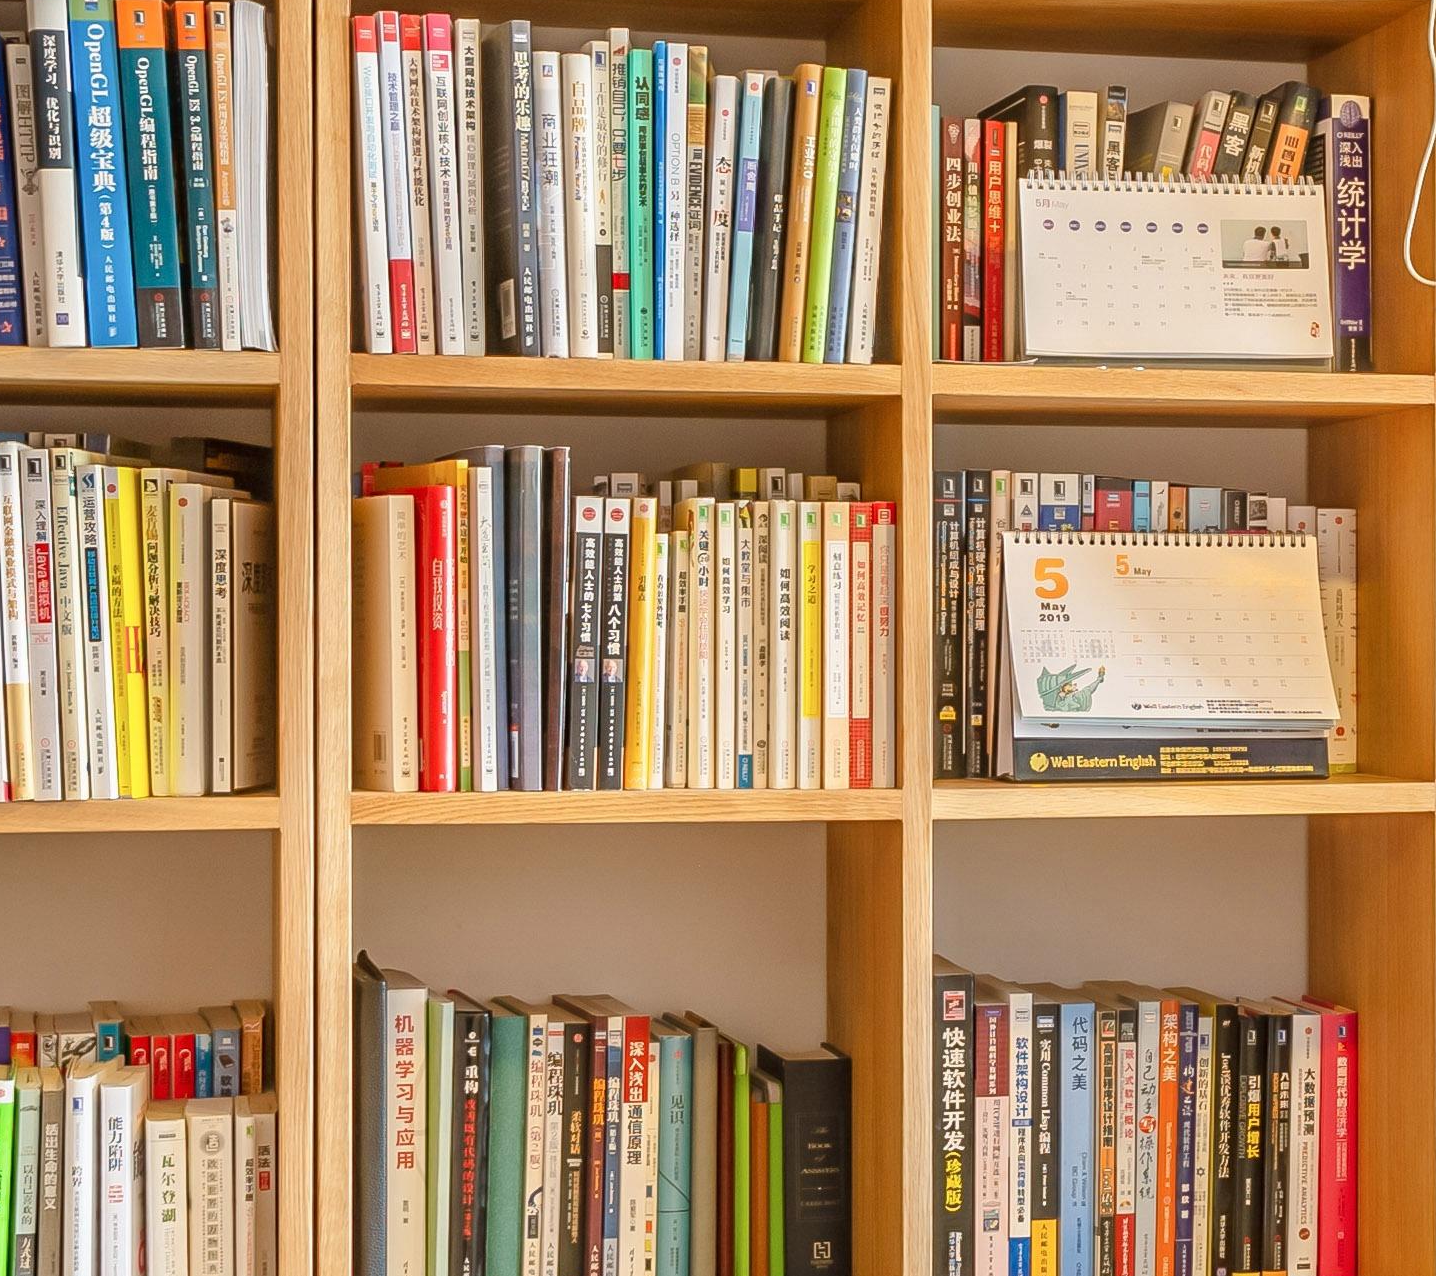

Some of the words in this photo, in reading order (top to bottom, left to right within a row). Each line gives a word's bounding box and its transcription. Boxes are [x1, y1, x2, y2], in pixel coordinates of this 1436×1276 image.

[43, 34, 63, 161] 深度学习、优化与识别
[87, 22, 107, 103] OpenGL
[513, 51, 531, 132] 思考的乐趣
[136, 57, 159, 182] OpenGL编程指南
[636, 76, 650, 121] 认同感
[87, 105, 114, 194] 超级宝典
[944, 157, 964, 243] 四步创业法
[1336, 176, 1367, 270] 统计学
[1033, 557, 1069, 599] 5
[1116, 554, 1130, 577] 5
[1133, 566, 1152, 577] May
[779, 569, 791, 642] 如何高效阅读
[1038, 612, 1071, 623] 2019
[1040, 602, 1067, 613] May
[1051, 754, 1075, 768] Well
[1076, 754, 1118, 768] Eastern
[1119, 754, 1157, 769] English
[628, 1040, 646, 1102] 深入浅出
[1015, 1036, 1029, 1117] 软件架构设计
[1072, 1016, 1088, 1091] 代码之美
[1163, 1013, 1177, 1083] 架构之美
[394, 1014, 415, 1171] 机器学习与应用
[943, 1027, 966, 1151] 快速软件开发
[1304, 1068, 1315, 1136] 大数据预测
[107, 1115, 123, 1174] 能力陷阱
[626, 1105, 644, 1165] 通信原理
[160, 1155, 176, 1225] 瓦尔登湖
